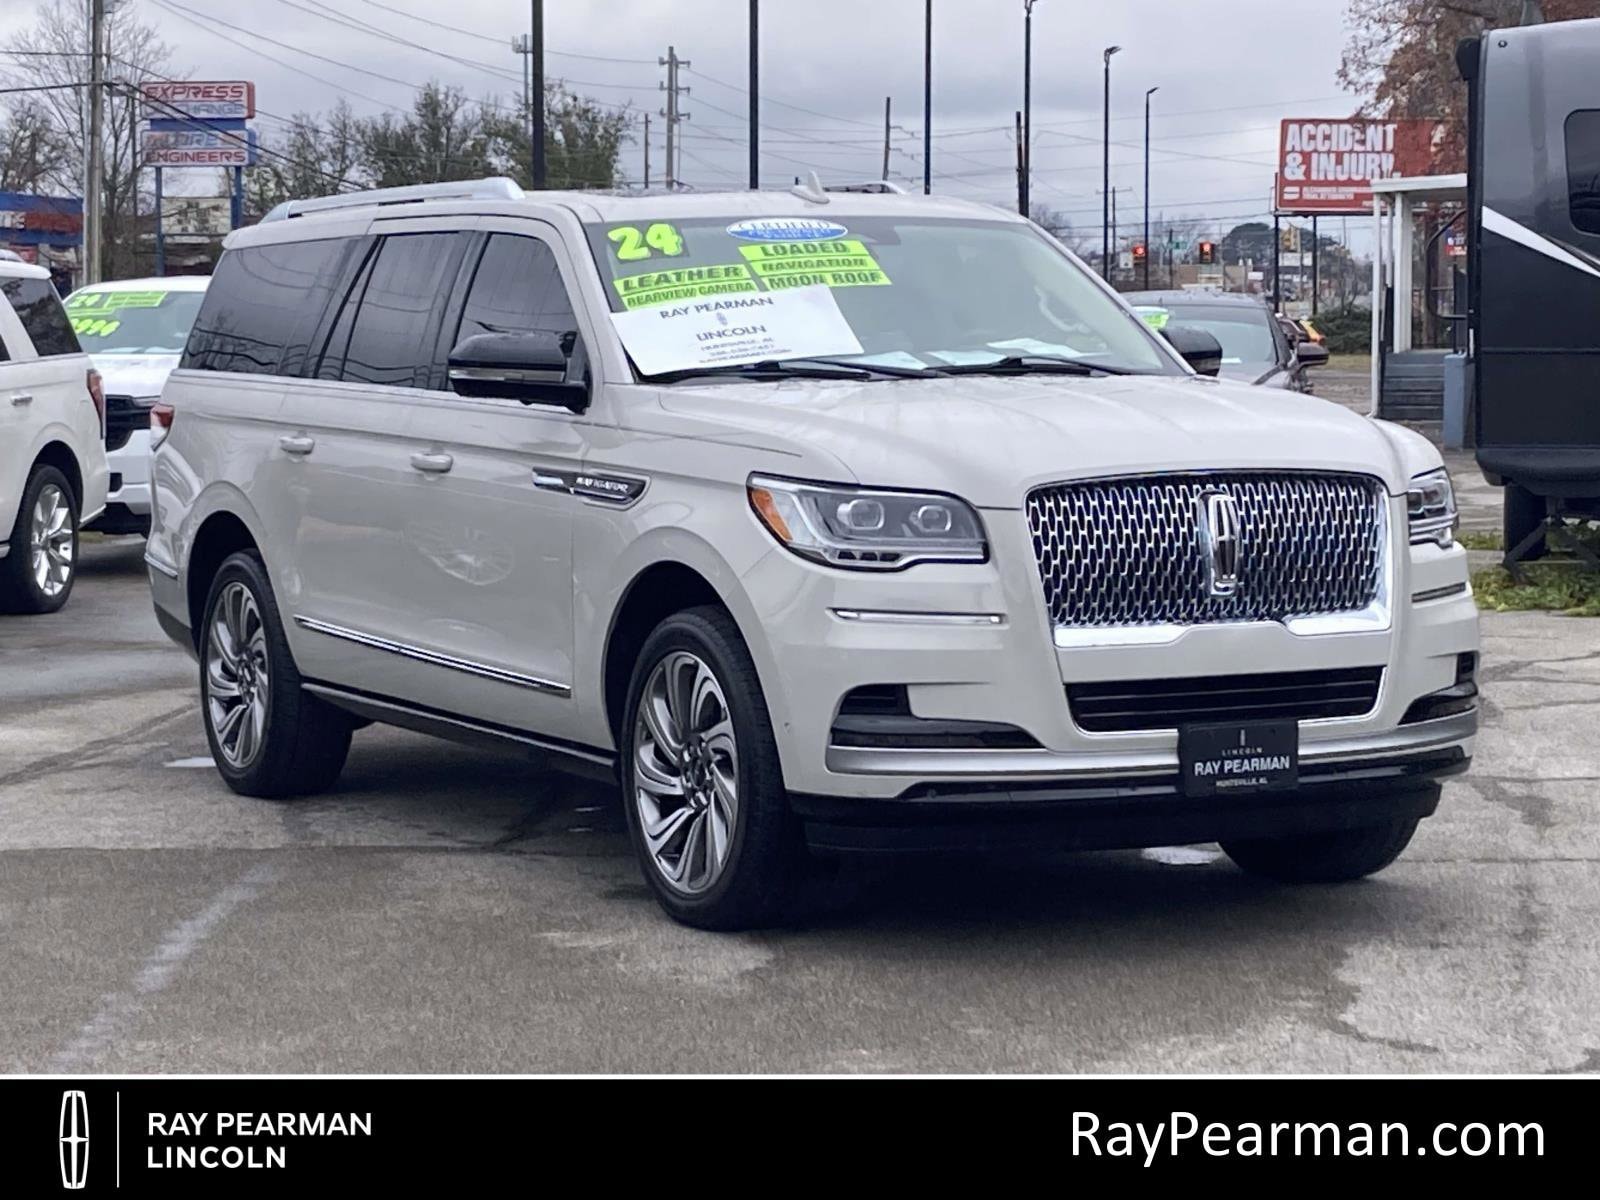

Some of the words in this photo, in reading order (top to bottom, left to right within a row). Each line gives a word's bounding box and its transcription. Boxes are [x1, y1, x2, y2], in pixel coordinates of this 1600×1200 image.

[145, 85, 244, 99] EXPRESS
[1285, 123, 1398, 152] ACCIDENT
[144, 151, 246, 163] ENGINEERS
[1283, 152, 1307, 181] &
[607, 222, 684, 261] 24
[760, 242, 850, 257] LOADED
[761, 257, 868, 272] NAVIGATION
[622, 264, 744, 293] LEATHER
[767, 274, 827, 291] MOON
[830, 271, 882, 285] ROOF
[626, 285, 697, 308] REARVIEW
[698, 280, 756, 297] CAMERA
[659, 306, 689, 319] RAY
[693, 295, 774, 314] PEARMAN
[695, 325, 767, 342] LINCOLN
[1221, 746, 1263, 757] LINCOLN
[1194, 760, 1221, 777] RAY
[1223, 755, 1290, 774] PEARMAN
